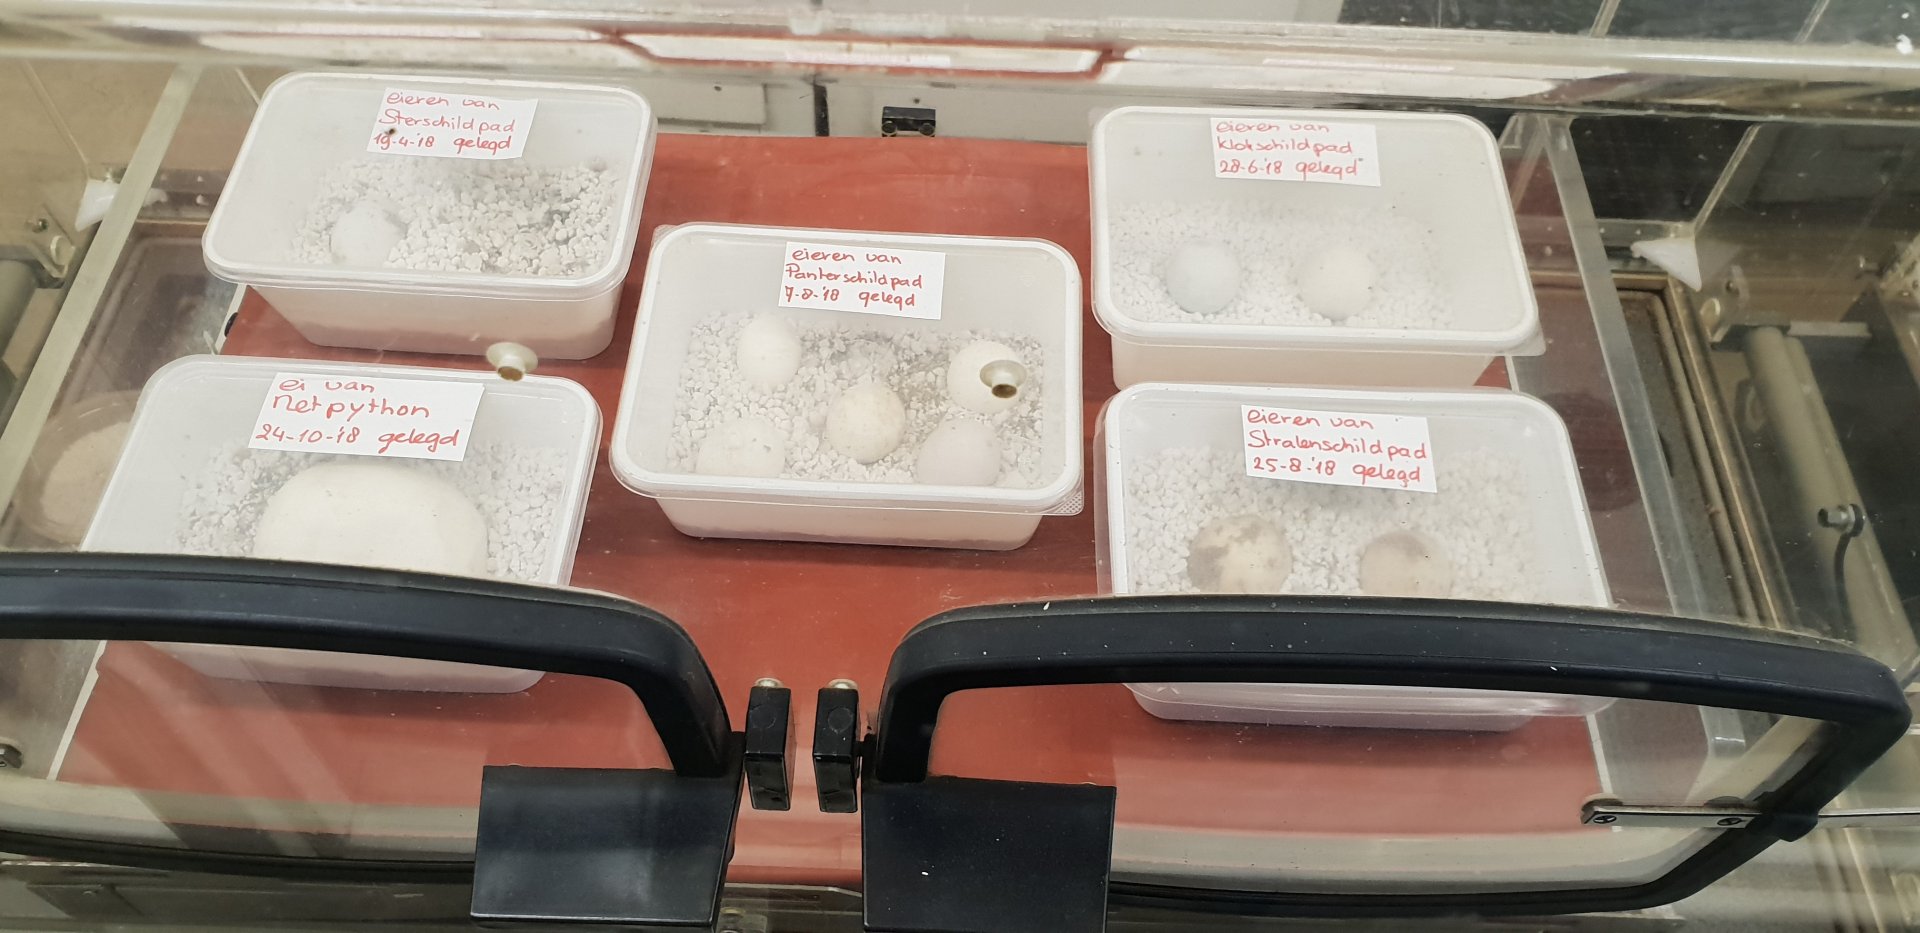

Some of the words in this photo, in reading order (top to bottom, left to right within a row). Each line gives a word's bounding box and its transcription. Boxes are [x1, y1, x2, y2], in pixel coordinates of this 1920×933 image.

[386, 91, 449, 106] eieren
[462, 98, 500, 110] van
[378, 108, 516, 135] Sterschildpad
[1216, 121, 1280, 133] eieren
[1289, 123, 1329, 133] van
[453, 135, 512, 155] gelegd
[1295, 159, 1357, 181] gelegd
[792, 248, 855, 261] eieren
[866, 253, 902, 265] van
[785, 263, 922, 291] Panterschildpad
[858, 291, 915, 311] gelegd
[279, 379, 305, 391] ei
[325, 380, 374, 393] van
[1247, 409, 1320, 427] eieren
[1329, 417, 1374, 430] van
[378, 428, 459, 454] gelegd
[1247, 429, 1427, 461] Stralenschildpad
[1352, 463, 1421, 488] gelegd
